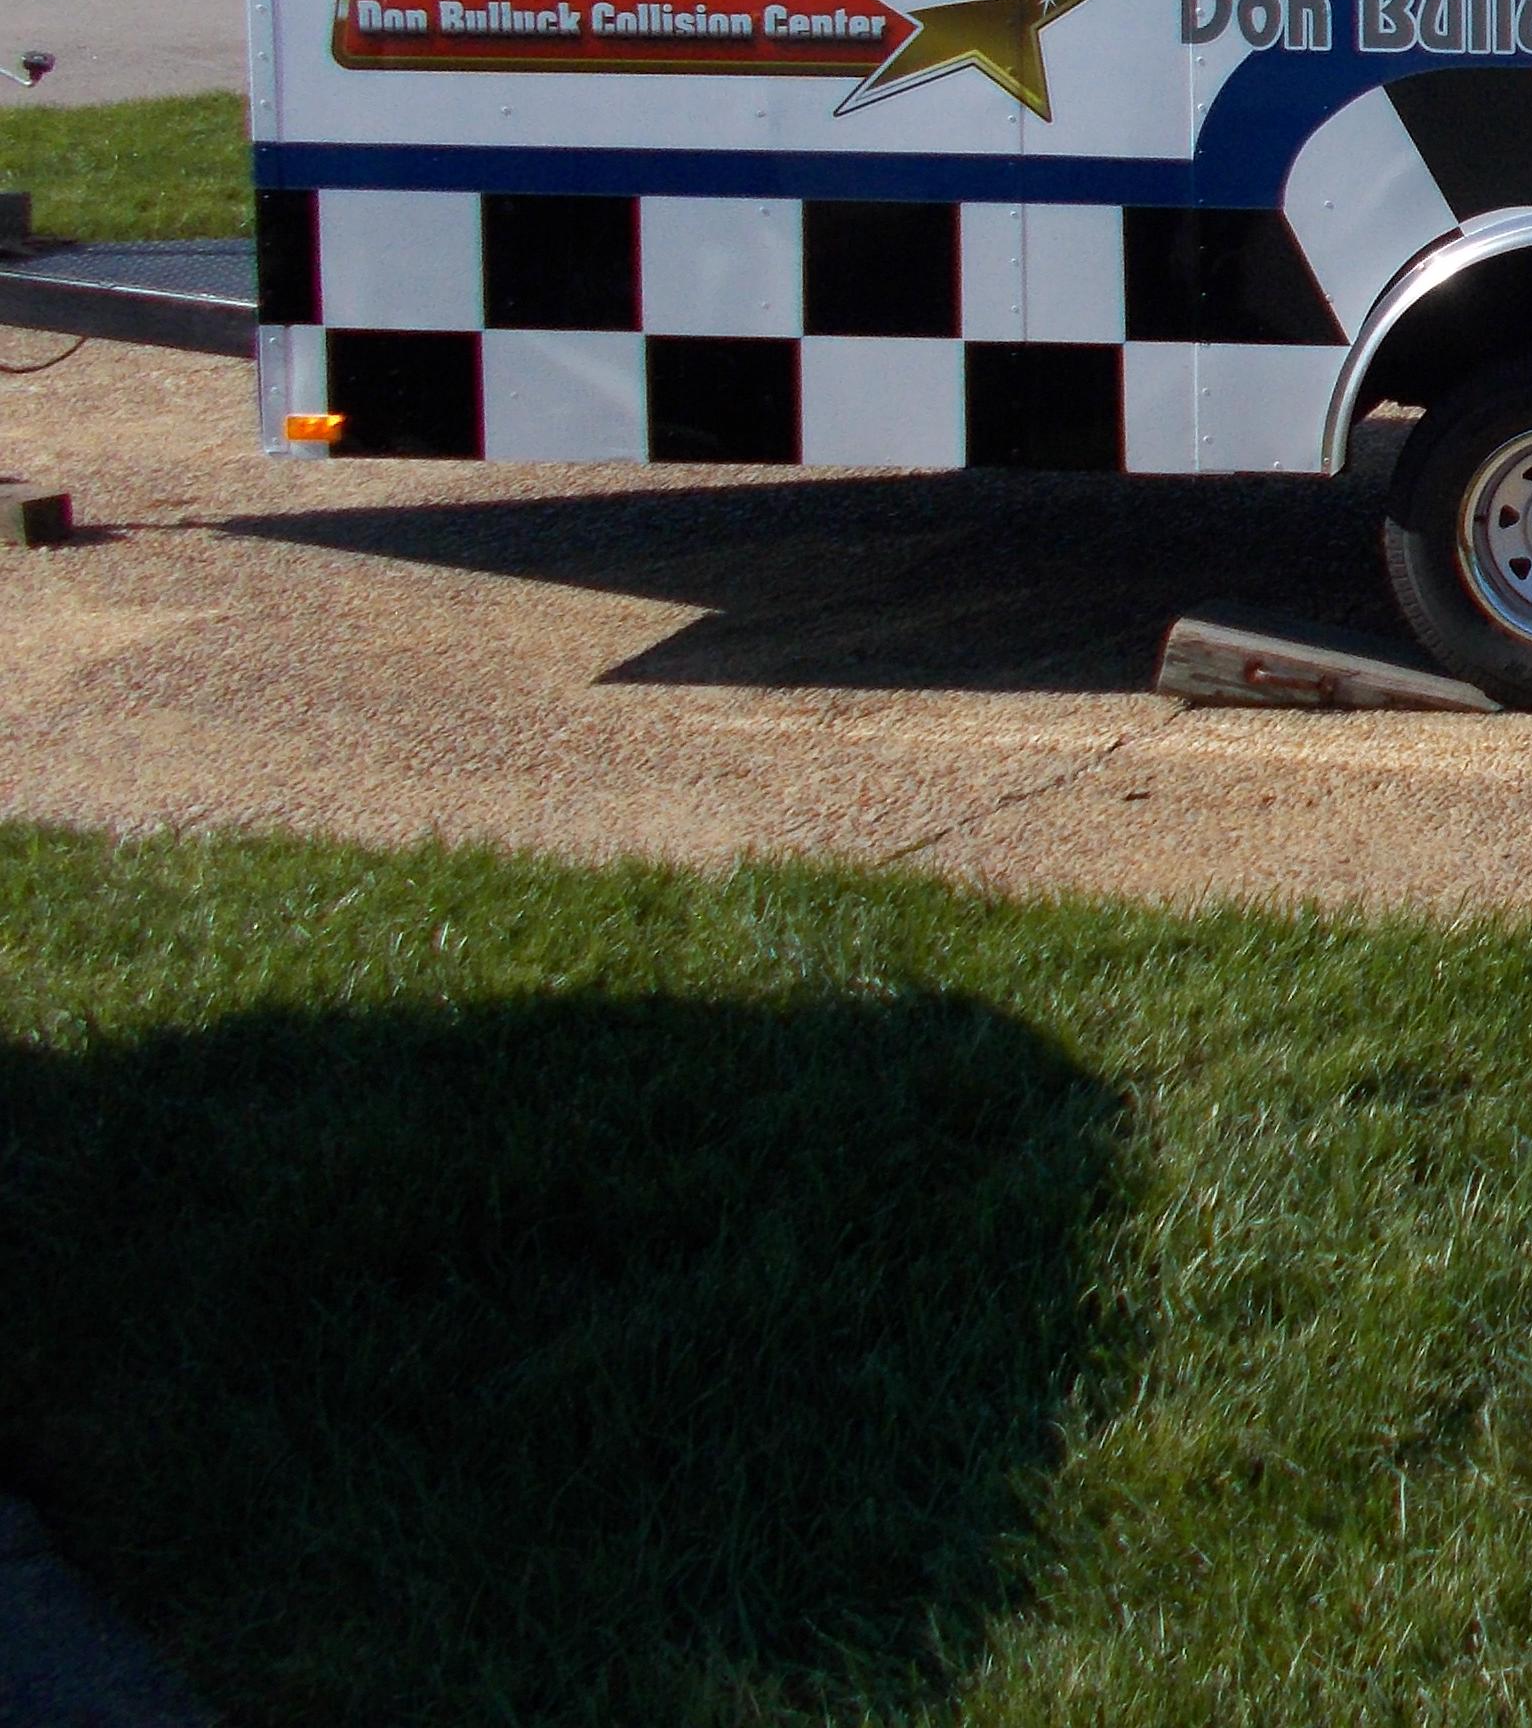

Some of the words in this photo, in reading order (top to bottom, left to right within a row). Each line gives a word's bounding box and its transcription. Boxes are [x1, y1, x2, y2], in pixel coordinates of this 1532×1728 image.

[438, 0, 580, 39] Bulluck
[590, 1, 748, 40] Collision
[763, 3, 887, 42] Center
